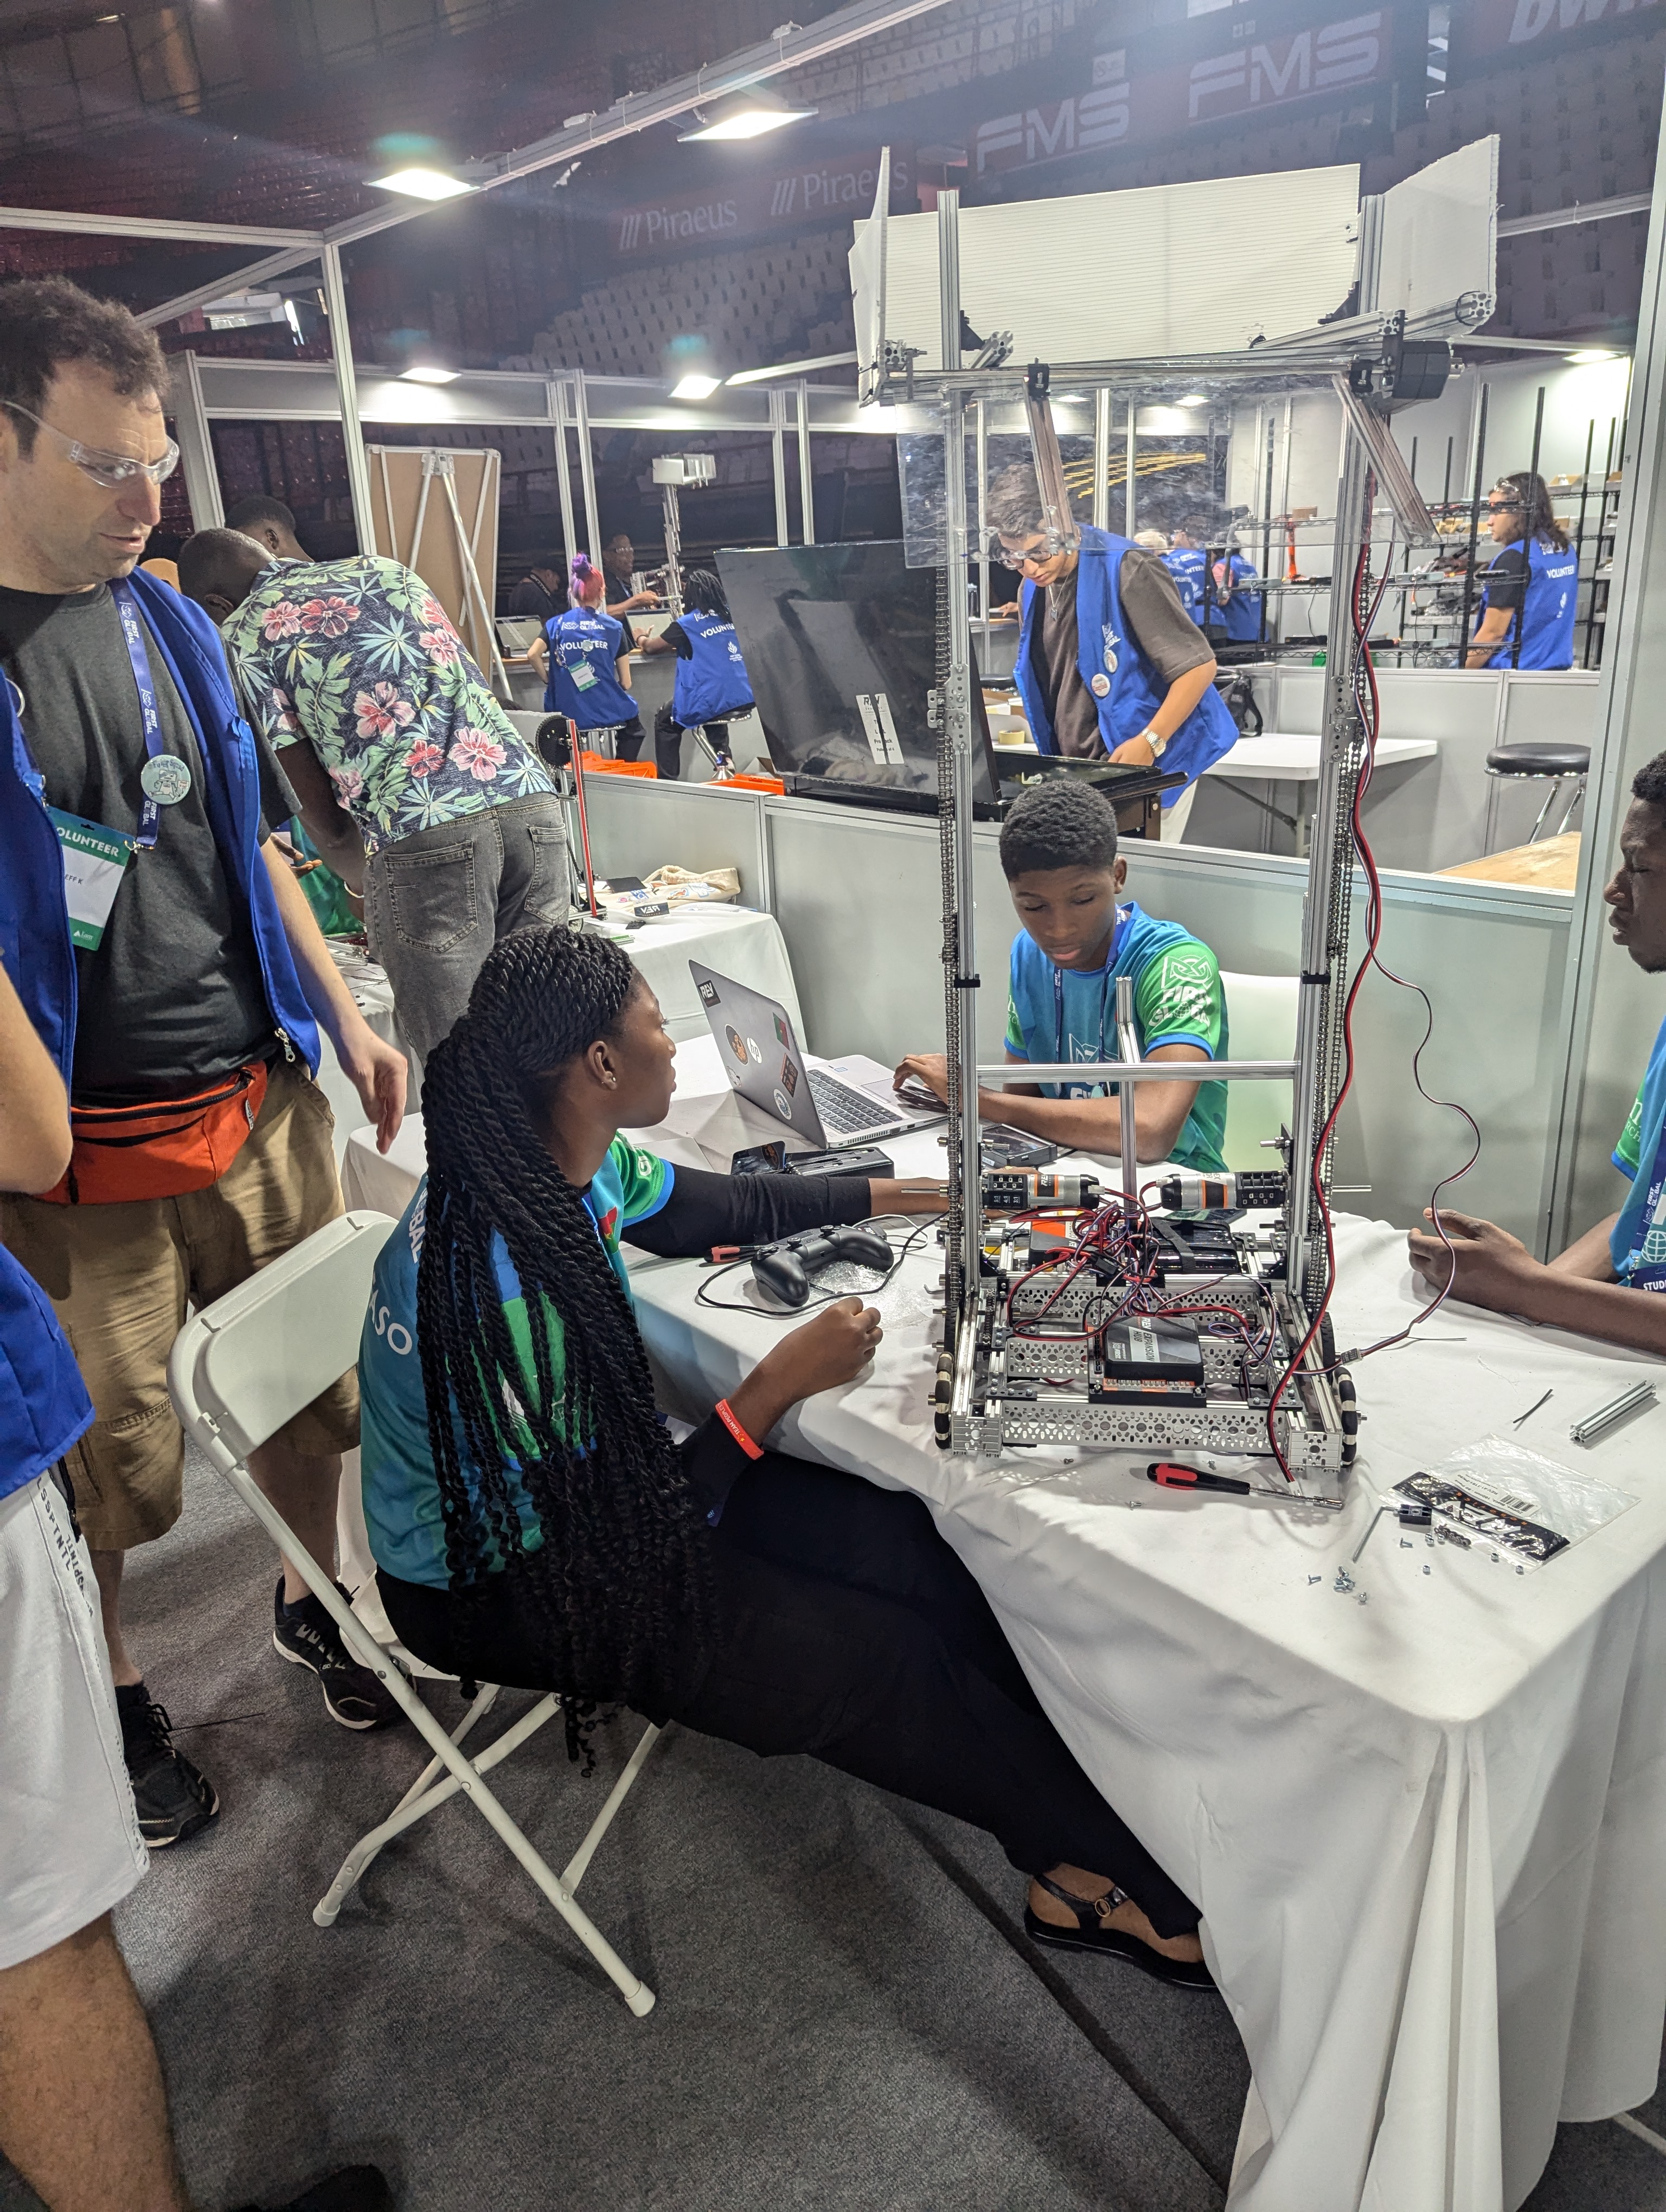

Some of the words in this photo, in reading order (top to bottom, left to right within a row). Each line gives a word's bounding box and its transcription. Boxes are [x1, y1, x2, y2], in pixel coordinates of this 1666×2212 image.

[1189, 11, 1382, 119] FMS
[976, 82, 1130, 174] FMS
[803, 161, 908, 208] Piraes
[647, 200, 738, 243] Piraeus
[130, 620, 139, 638] FIRST
[560, 640, 608, 651] VOLUTEER
[863, 696, 880, 705] RV
[56, 827, 119, 858] OLUNTEER
[65, 874, 77, 883] EFF
[700, 982, 714, 999] REV
[1149, 1001, 1210, 1027] GLOBA
[750, 1045, 759, 1059] hp
[1069, 1240, 1077, 1249] EV
[1643, 1279, 1666, 1291] STUD
[369, 1271, 412, 1355] ASO
[1142, 1317, 1152, 1330] REV
[1133, 1330, 1143, 1342] HUB
[1143, 1332, 1155, 1362] EXPANSION
[729, 1421, 740, 1435] TEAM
